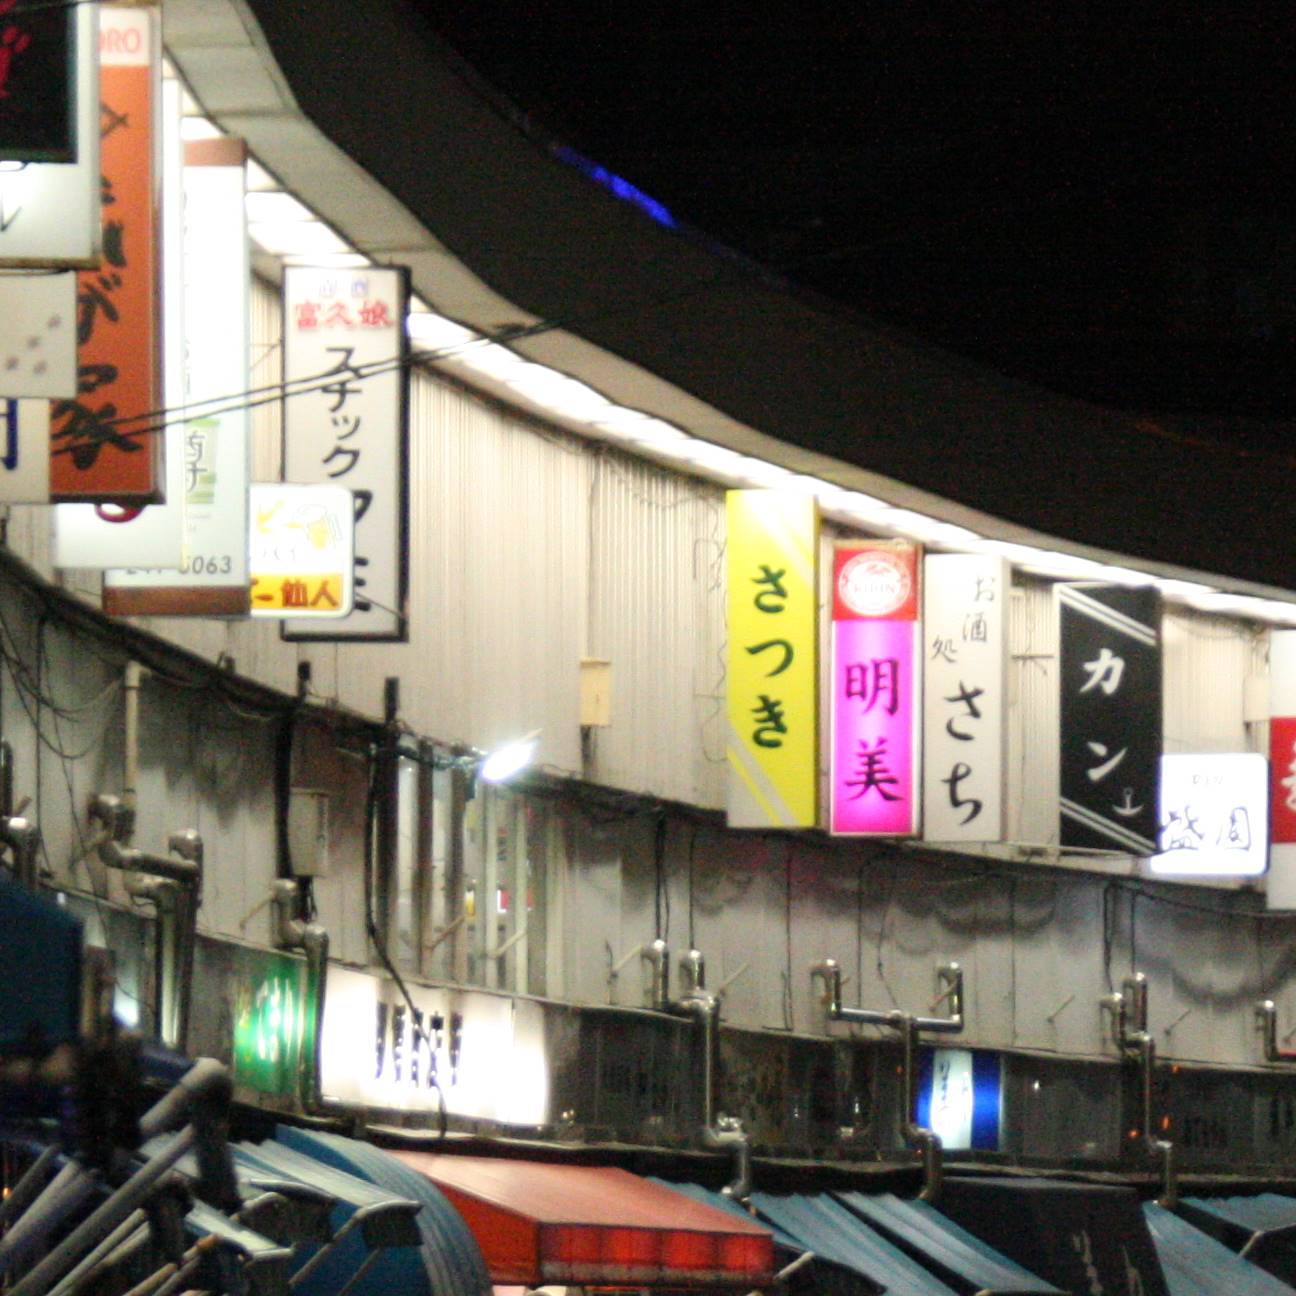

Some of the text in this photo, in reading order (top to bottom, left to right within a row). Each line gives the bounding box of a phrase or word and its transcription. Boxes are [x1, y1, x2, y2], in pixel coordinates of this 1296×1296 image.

[319, 347, 362, 478] スナック
[747, 563, 795, 750] さつき
[843, 655, 901, 802] 明美
[1078, 647, 1127, 782] カン
[943, 679, 987, 825] さち
